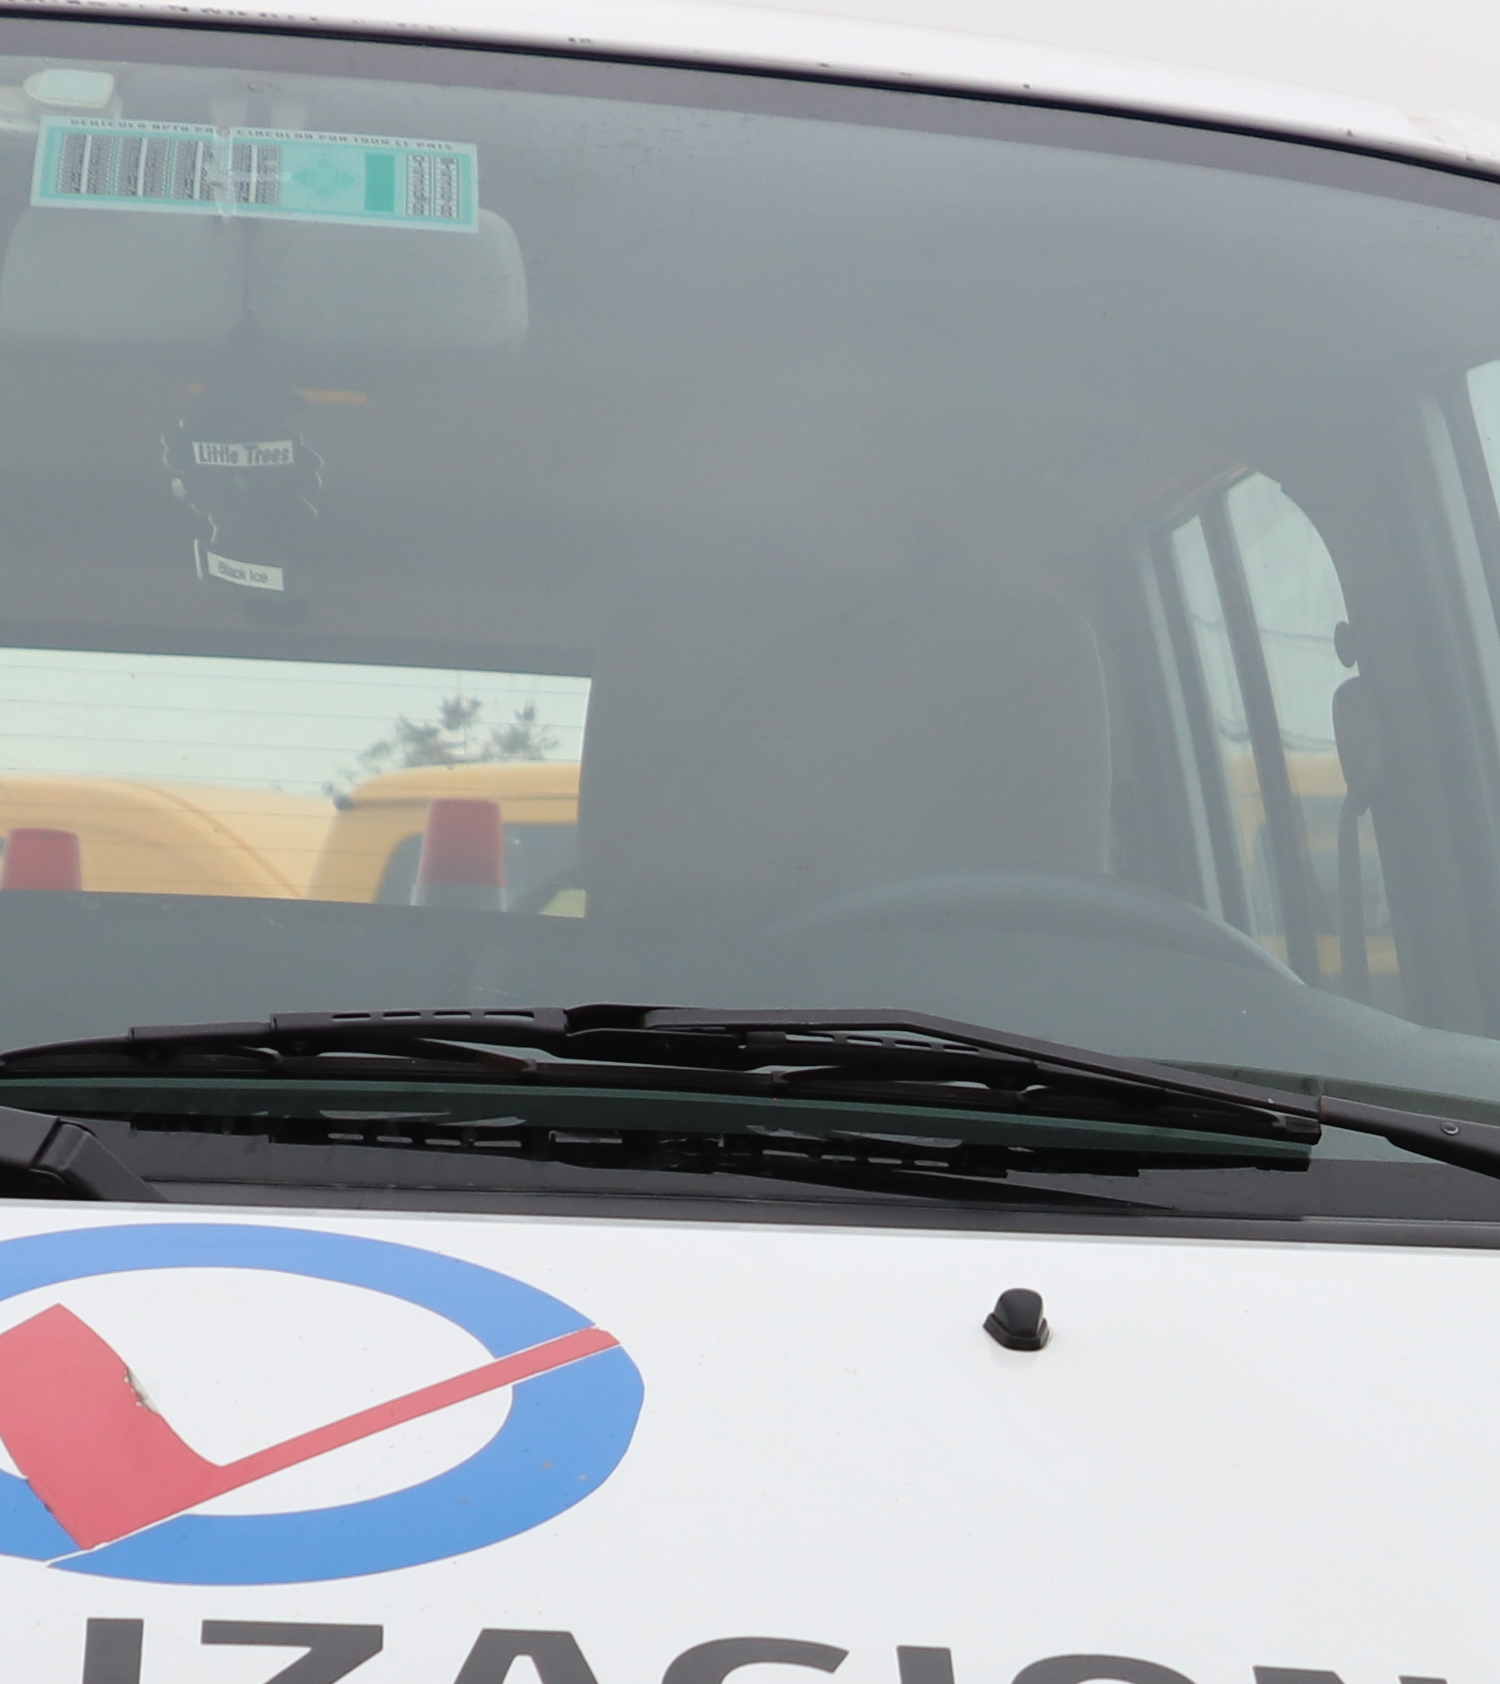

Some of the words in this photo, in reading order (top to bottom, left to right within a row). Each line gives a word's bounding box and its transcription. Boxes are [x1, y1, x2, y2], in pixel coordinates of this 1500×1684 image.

[198, 444, 238, 464] Little
[242, 444, 290, 464] Trees
[218, 560, 246, 581] Black
[249, 568, 268, 584] Ice
